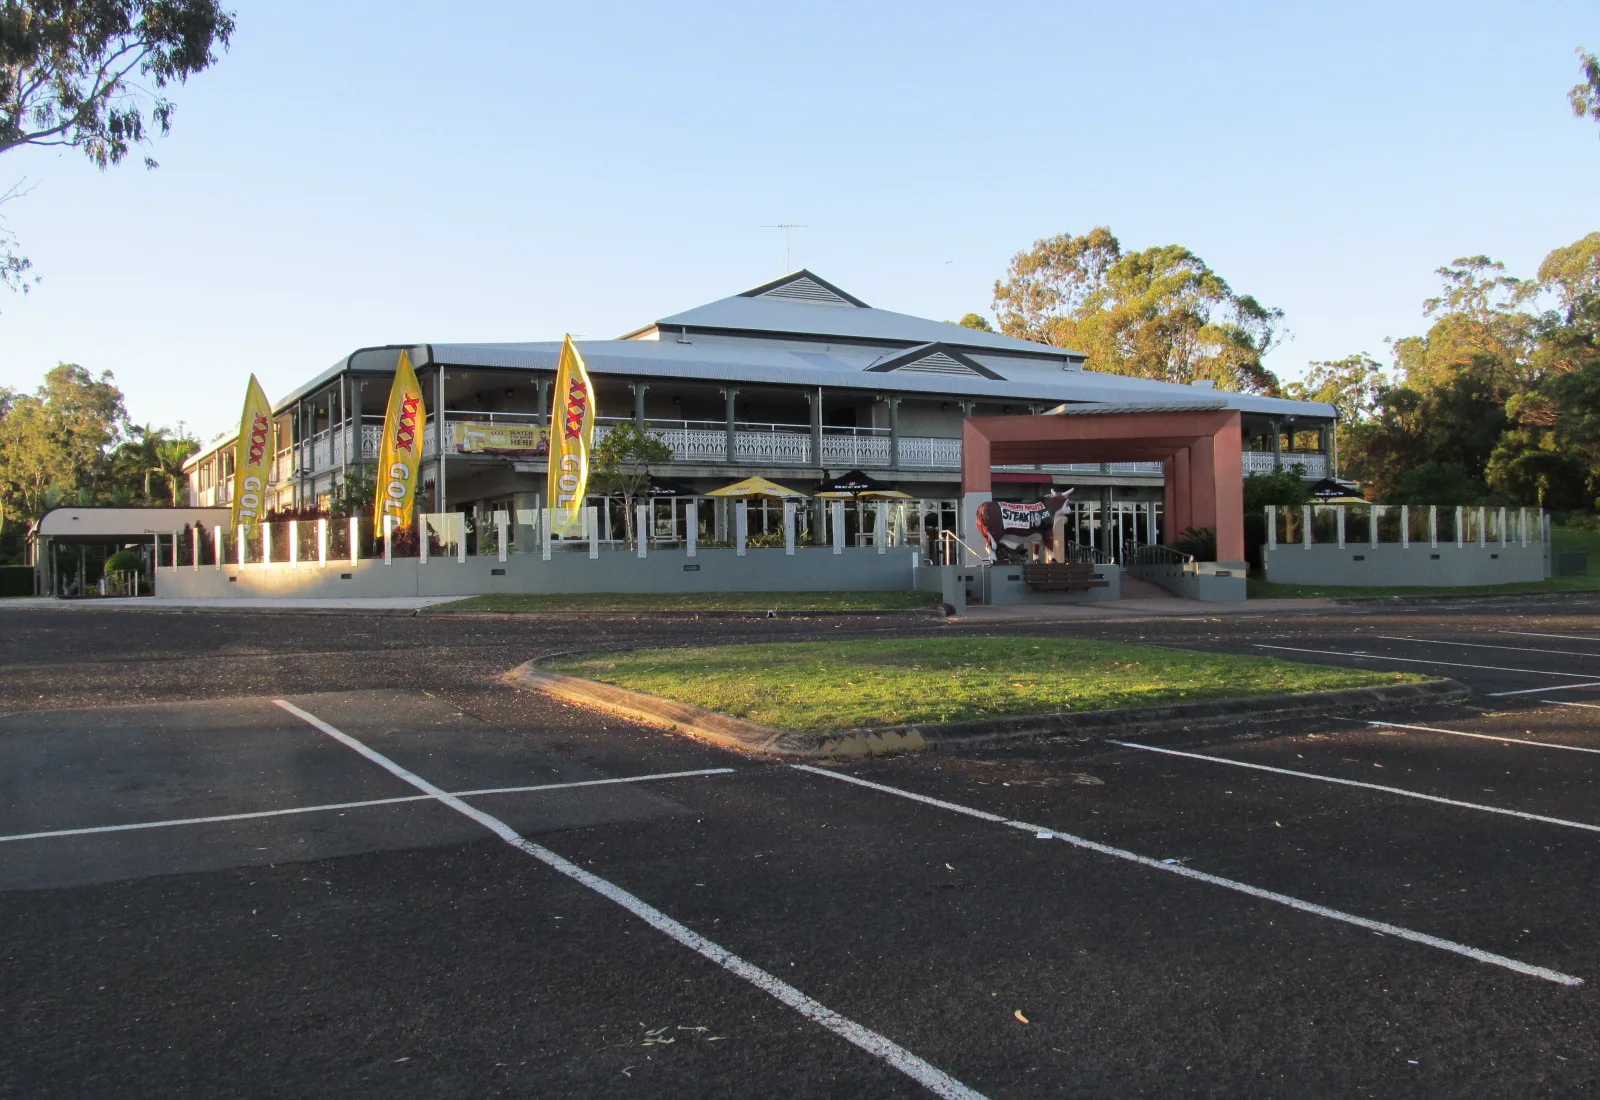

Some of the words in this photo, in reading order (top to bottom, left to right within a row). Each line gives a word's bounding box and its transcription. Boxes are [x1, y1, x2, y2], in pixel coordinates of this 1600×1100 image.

[249, 412, 269, 467] XXXX
[396, 392, 420, 453] XXXX
[565, 378, 587, 440] XXXX
[557, 453, 581, 527] GOLD
[1003, 509, 1029, 522] STEAK
